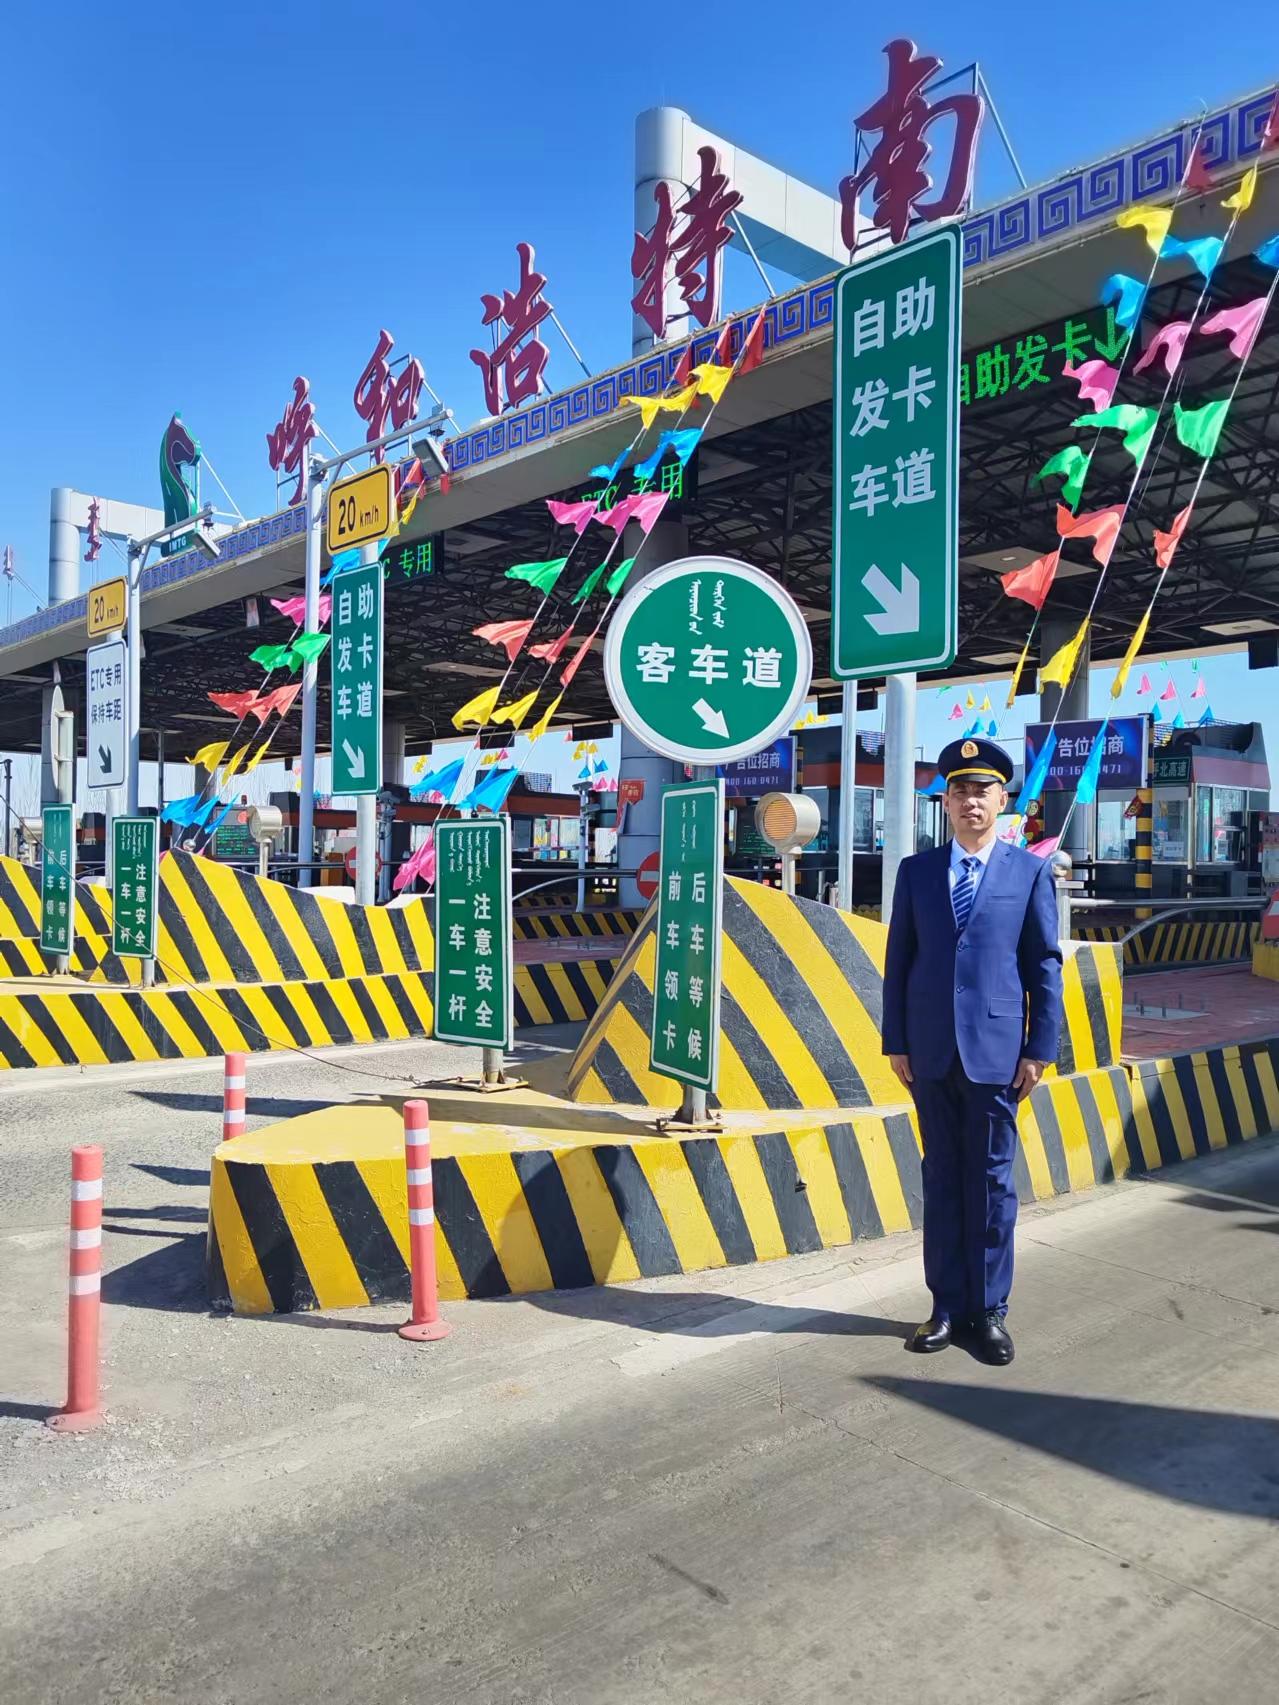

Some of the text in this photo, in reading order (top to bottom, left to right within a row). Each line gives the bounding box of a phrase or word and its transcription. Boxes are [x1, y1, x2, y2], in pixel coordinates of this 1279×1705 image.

[267, 38, 985, 506] 呼和浩特南
[853, 276, 936, 358] 自助
[849, 365, 936, 438] 发卡
[338, 495, 379, 536] 20 km/h
[581, 485, 619, 513] TC
[849, 447, 936, 518] 车道
[94, 596, 120, 625] 20 km/h
[338, 582, 374, 626] 自助
[90, 662, 122, 692] ETC专用
[337, 632, 373, 673] 发卡
[636, 642, 783, 689] 客车道
[90, 698, 122, 725] 保持车距
[337, 681, 373, 721] 车道
[120, 866, 132, 945] 一车一杆
[135, 863, 147, 948] 注意安全
[448, 897, 468, 1023] 一车一杆
[473, 892, 494, 1029] 注意安全
[662, 870, 682, 1051] 前车领卡
[687, 871, 706, 1062] 后车等候
